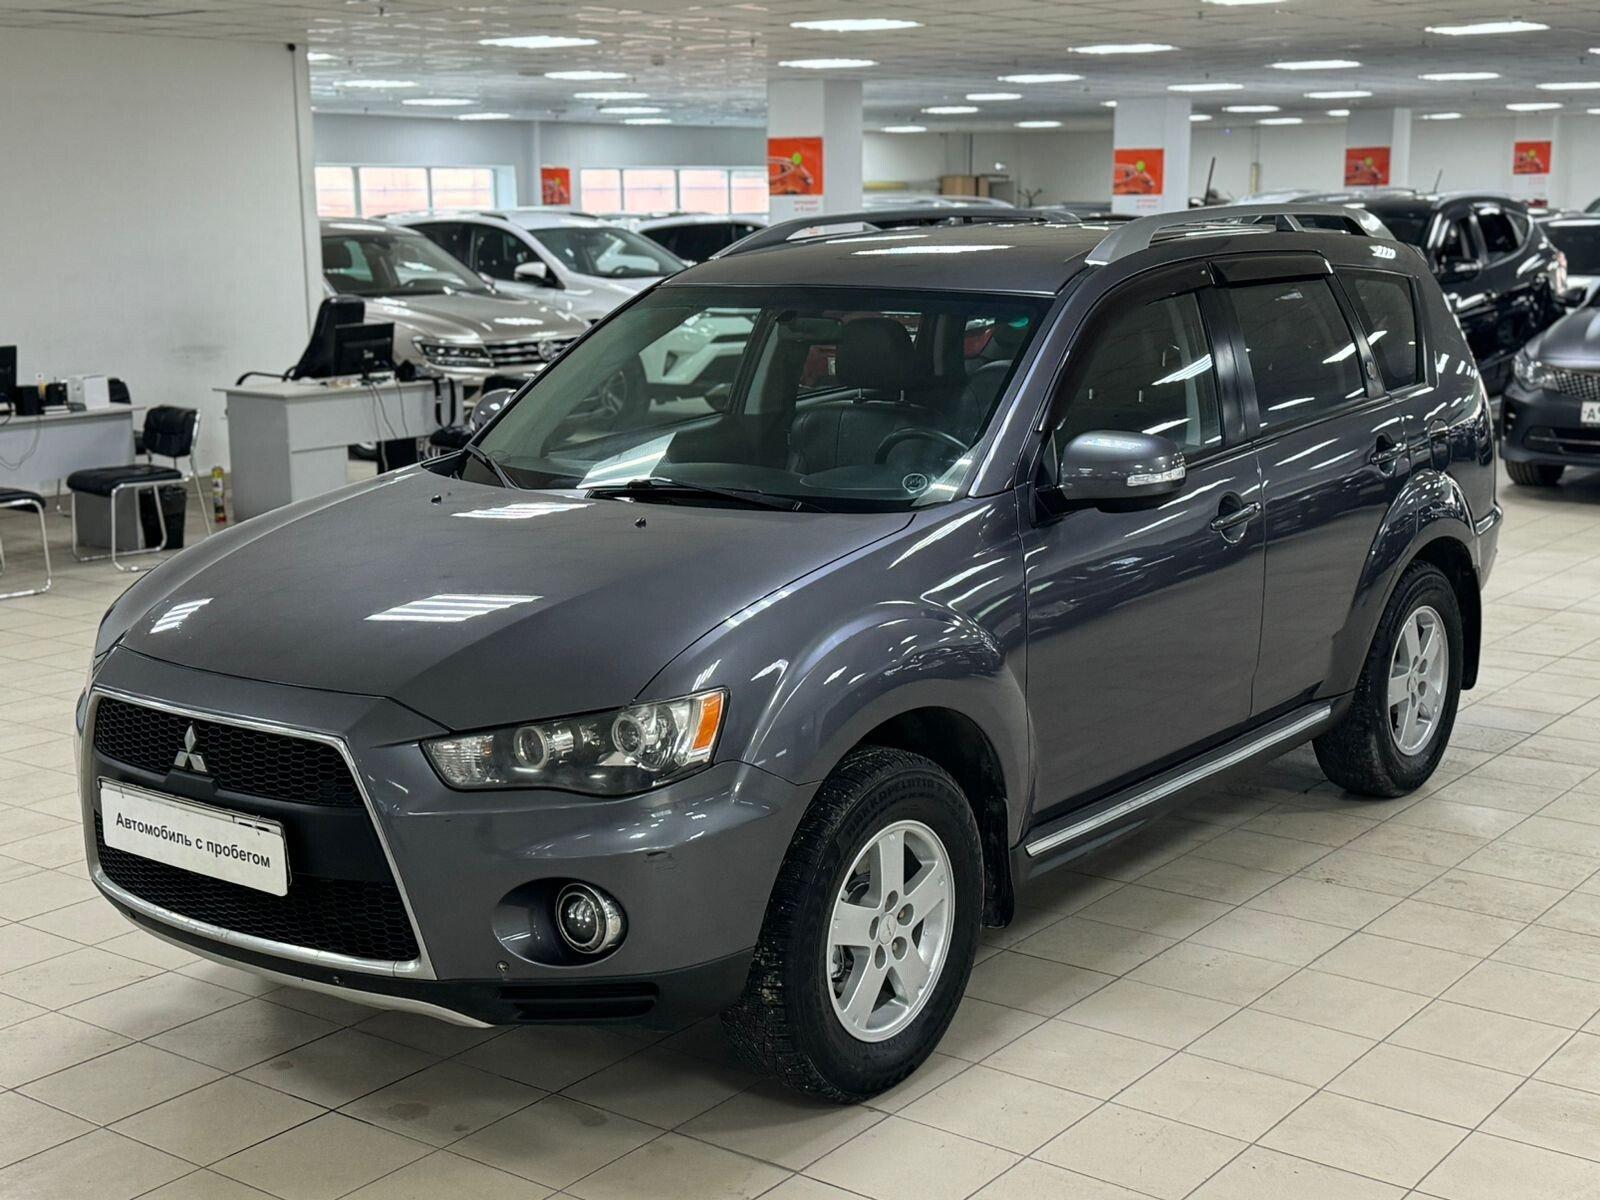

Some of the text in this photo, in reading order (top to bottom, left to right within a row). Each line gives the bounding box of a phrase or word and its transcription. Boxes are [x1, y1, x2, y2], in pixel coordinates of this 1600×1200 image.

[115, 812, 271, 869] Автомобиль с пробегом
